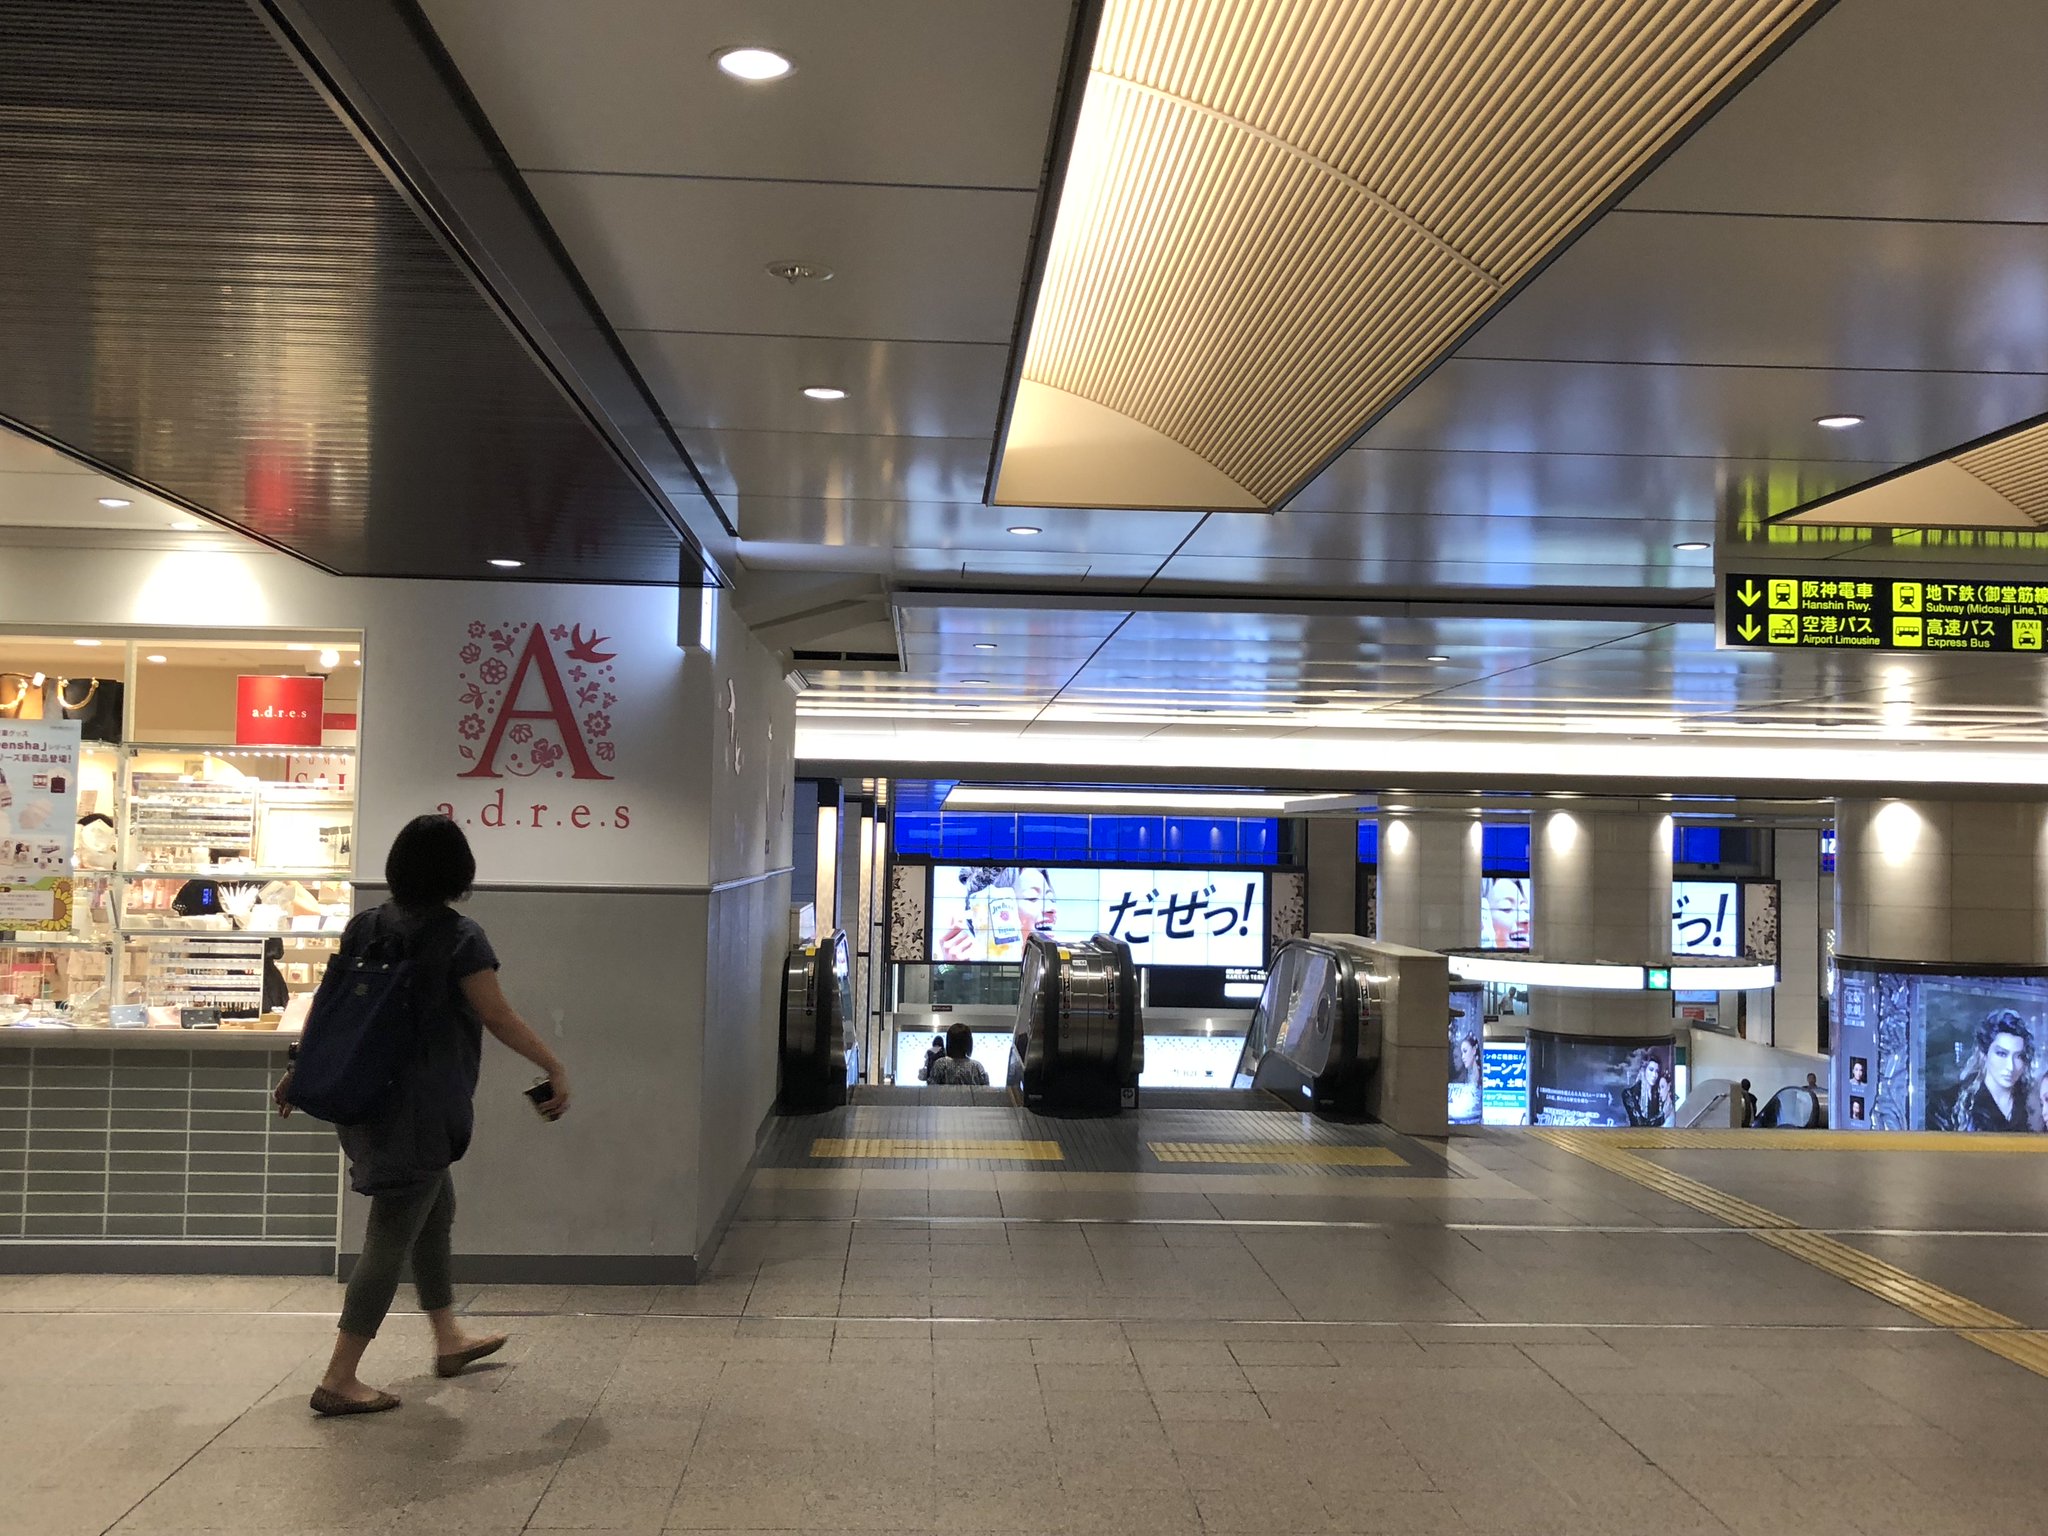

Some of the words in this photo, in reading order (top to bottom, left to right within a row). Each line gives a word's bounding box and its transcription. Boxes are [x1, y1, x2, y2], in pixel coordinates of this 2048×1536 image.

[1802, 581, 1873, 599] 阪神電車
[1802, 600, 1844, 611] Hanshin
[1847, 601, 1871, 613] Rwy.
[1926, 603, 1964, 615] Subway
[1967, 604, 2010, 616] (Midosuji
[1802, 615, 1872, 634] 空港バス
[1926, 618, 1995, 637] 高速バス
[2015, 622, 2039, 630] TAXI
[1802, 634, 1833, 646] Airport
[1835, 635, 1880, 646] Limousine
[1927, 637, 1967, 649] Express
[1970, 639, 1991, 648] Bus
[457, 622, 615, 780] A
[252, 705, 308, 719] a.d.r.e.s
[0, 741, 47, 752] ensha」
[1109, 883, 1255, 944] だぜっ!
[1673, 893, 1729, 948] っ!
